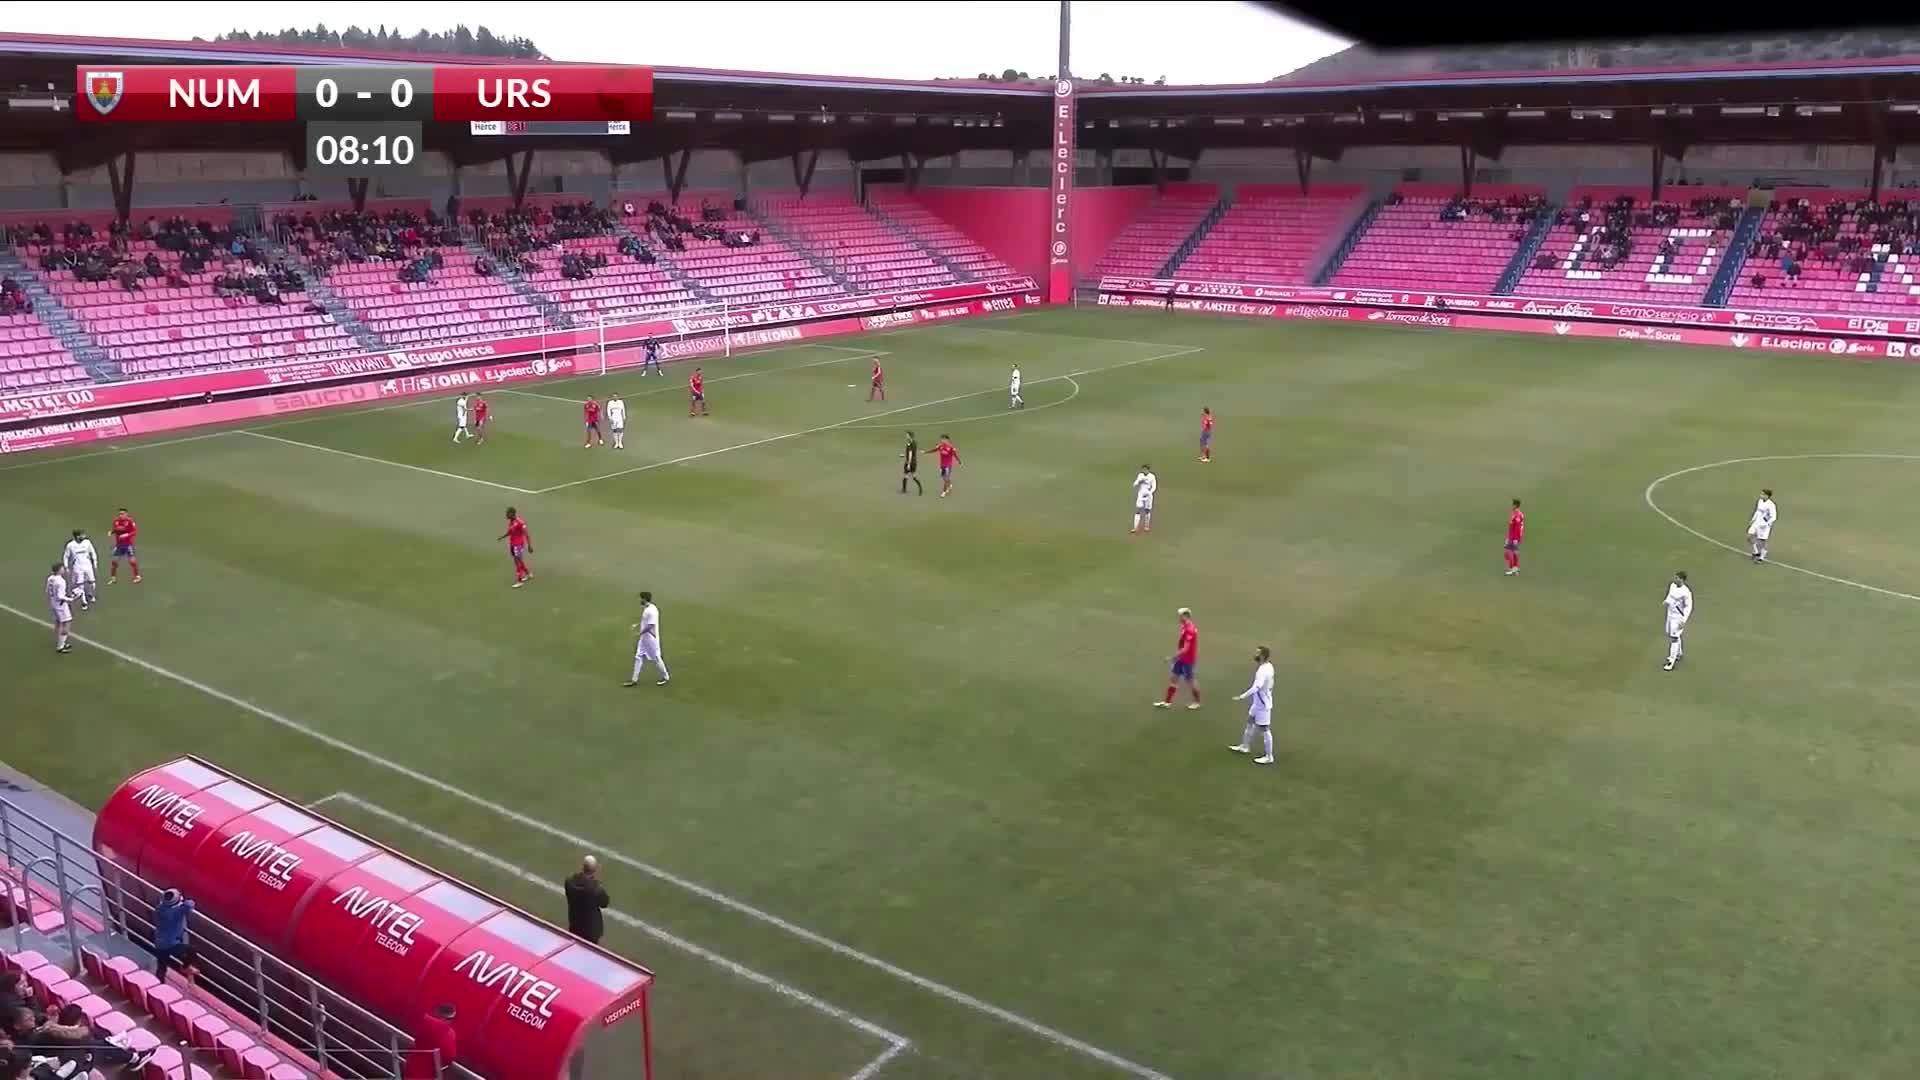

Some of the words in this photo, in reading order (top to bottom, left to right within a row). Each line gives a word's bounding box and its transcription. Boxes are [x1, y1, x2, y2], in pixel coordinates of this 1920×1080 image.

[475, 123, 497, 131] Herce
[751, 305, 818, 323] PLAZA
[1203, 301, 1237, 313] AMSTEL
[1611, 304, 1699, 321] termoservicio
[687, 316, 720, 331] Grupo
[720, 313, 749, 327] Herce
[1752, 313, 1818, 327] RIOSA
[410, 350, 454, 365] Grupo
[456, 344, 495, 359] Herce
[132, 784, 206, 830] AVATEL
[162, 819, 190, 839] TELECOM
[221, 830, 304, 882] AVATEL
[256, 870, 289, 892] TELECOM
[331, 885, 426, 946] AVATEL
[374, 932, 409, 957] TELECOM
[453, 949, 562, 1018] AVATEL
[506, 1002, 547, 1031] TELECOM
[604, 997, 641, 1024] VISITANTE
